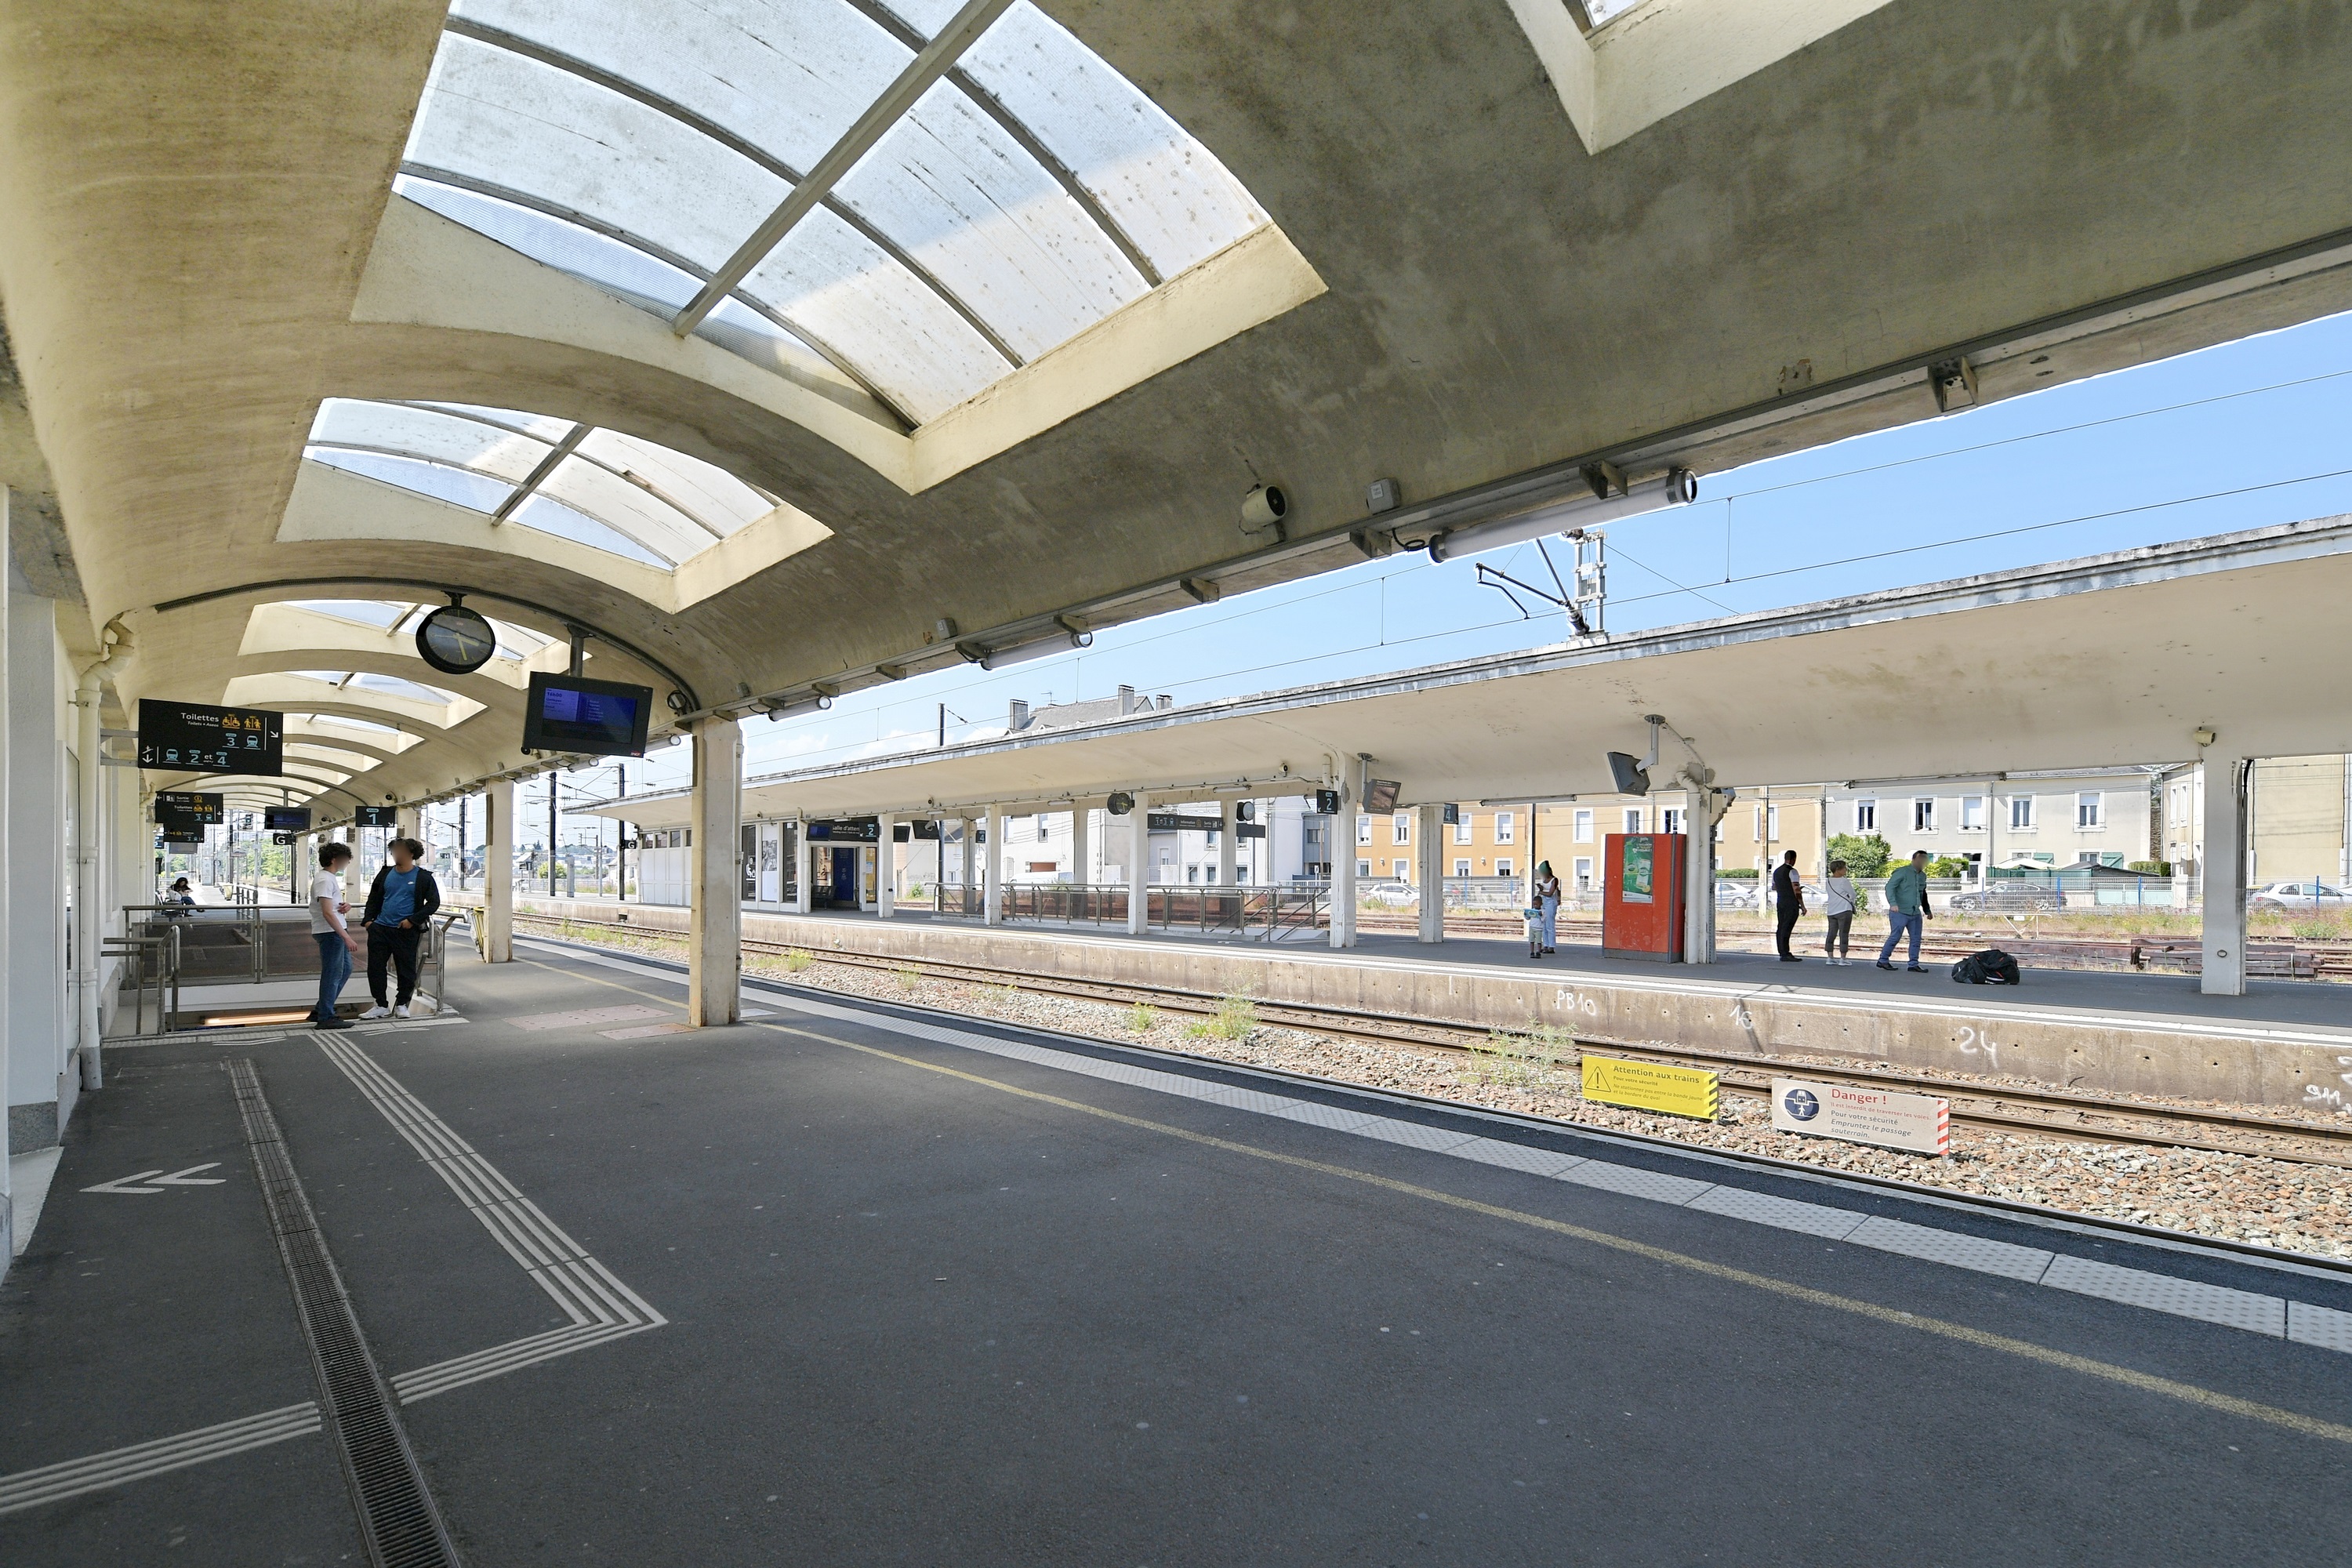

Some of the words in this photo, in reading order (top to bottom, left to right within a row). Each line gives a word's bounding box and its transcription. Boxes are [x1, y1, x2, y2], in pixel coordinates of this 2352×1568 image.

[180, 712, 220, 722] Toilettes
[227, 737, 235, 746] 3
[191, 754, 199, 764] 2
[217, 756, 226, 765] 4
[1327, 798, 1332, 810] 2
[368, 813, 376, 824] 1
[1446, 810, 1451, 821] 4
[276, 836, 285, 845] G
[1959, 1026, 1998, 1069] 24
[1613, 1065, 1653, 1077] Attention
[1674, 1074, 1700, 1083] trains
[1621, 1084, 1644, 1093] stationnez
[1831, 1088, 1878, 1105] Danger
[1883, 1095, 1886, 1105] !
[1831, 1109, 1847, 1118] Pour
[1869, 1116, 1899, 1126] sécurité
[1831, 1119, 1871, 1131] Empruntez
[1880, 1127, 1911, 1138] passage
[1831, 1127, 1870, 1138] souterrain.
